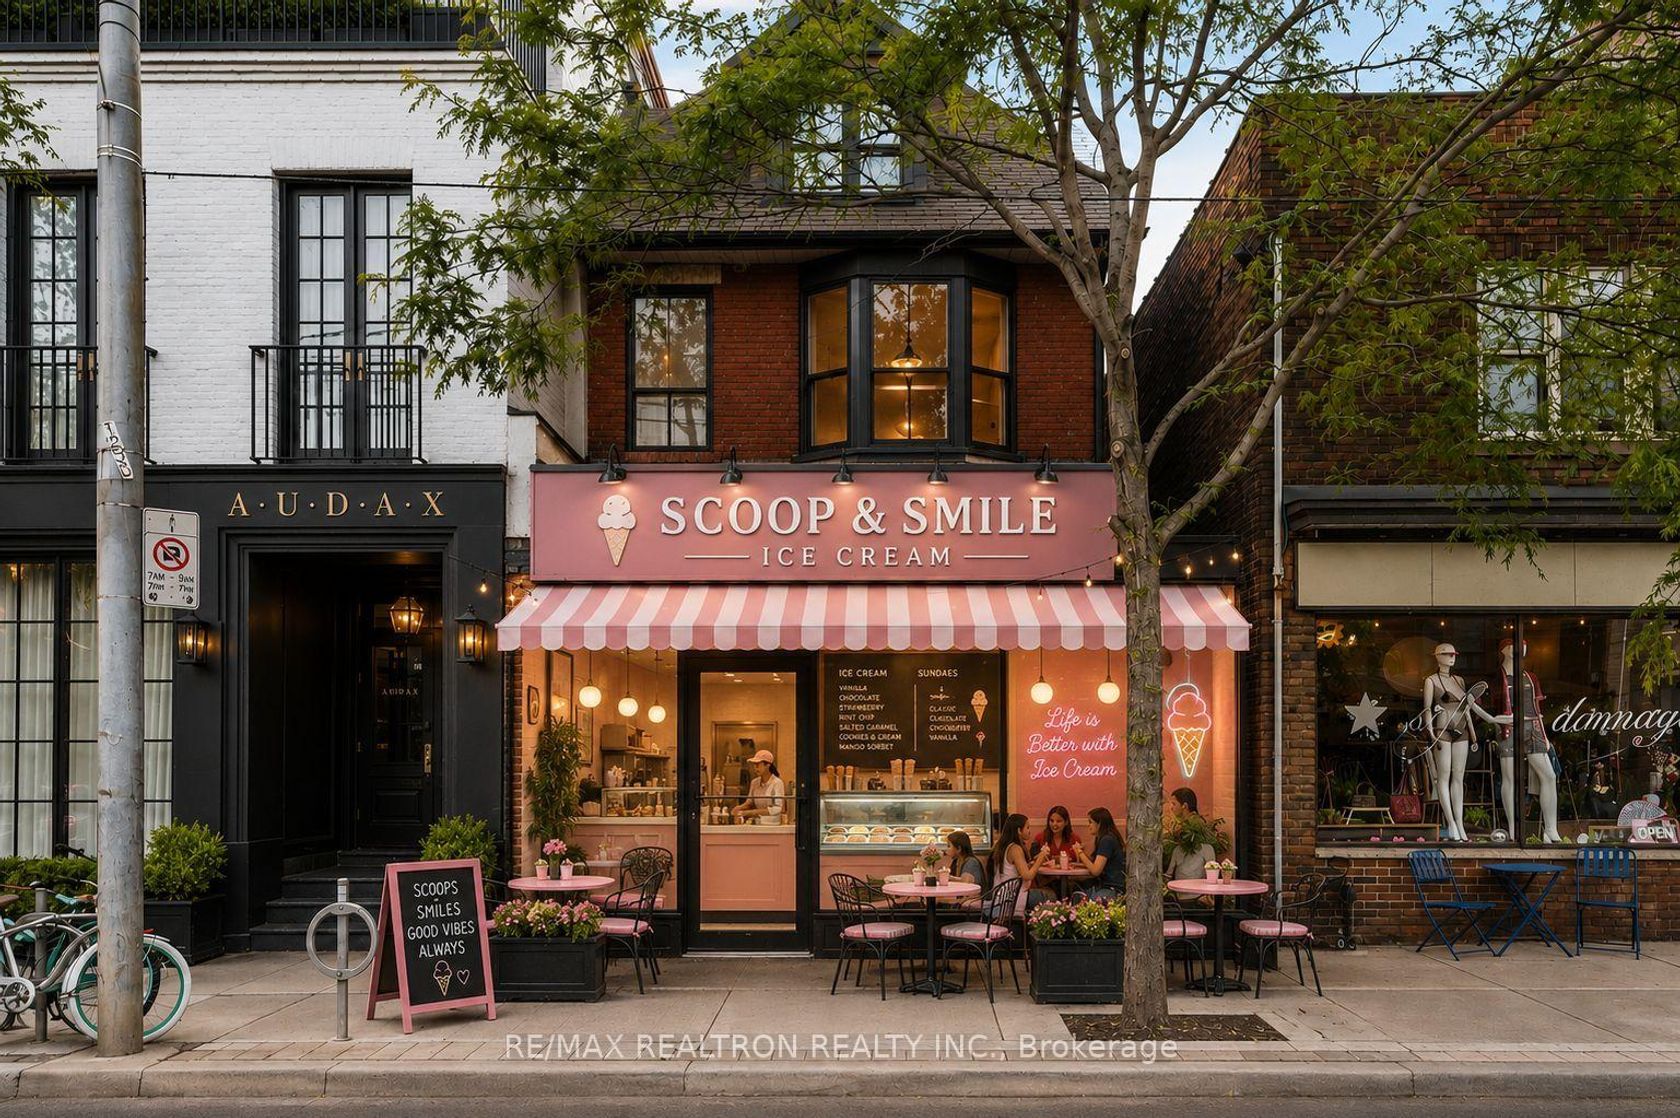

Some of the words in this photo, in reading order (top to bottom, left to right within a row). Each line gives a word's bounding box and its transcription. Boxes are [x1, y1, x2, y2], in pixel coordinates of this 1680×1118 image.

[661, 496, 835, 535] SCOOP
[852, 496, 886, 535] &
[903, 496, 1057, 535] SMILE
[762, 546, 817, 566] ICE
[836, 546, 951, 566] CREAM
[148, 571, 165, 580] 7AM
[839, 669, 853, 678] ICE
[855, 669, 888, 678] CREAM
[917, 668, 959, 678] SUNDAES
[838, 694, 880, 702] CHOCOLATE
[1043, 706, 1083, 734] Life
[1085, 712, 1101, 727] is
[1026, 733, 1079, 754] Better
[1082, 732, 1119, 752] with
[1030, 758, 1060, 780] Ice
[1062, 757, 1118, 779] Cream
[1637, 824, 1677, 840] OPEN
[413, 879, 459, 898] SCOOPS
[416, 901, 461, 920] SMILES
[407, 924, 439, 941] GOOD
[441, 920, 475, 937] VIBES
[418, 939, 466, 959] ALWAYS
